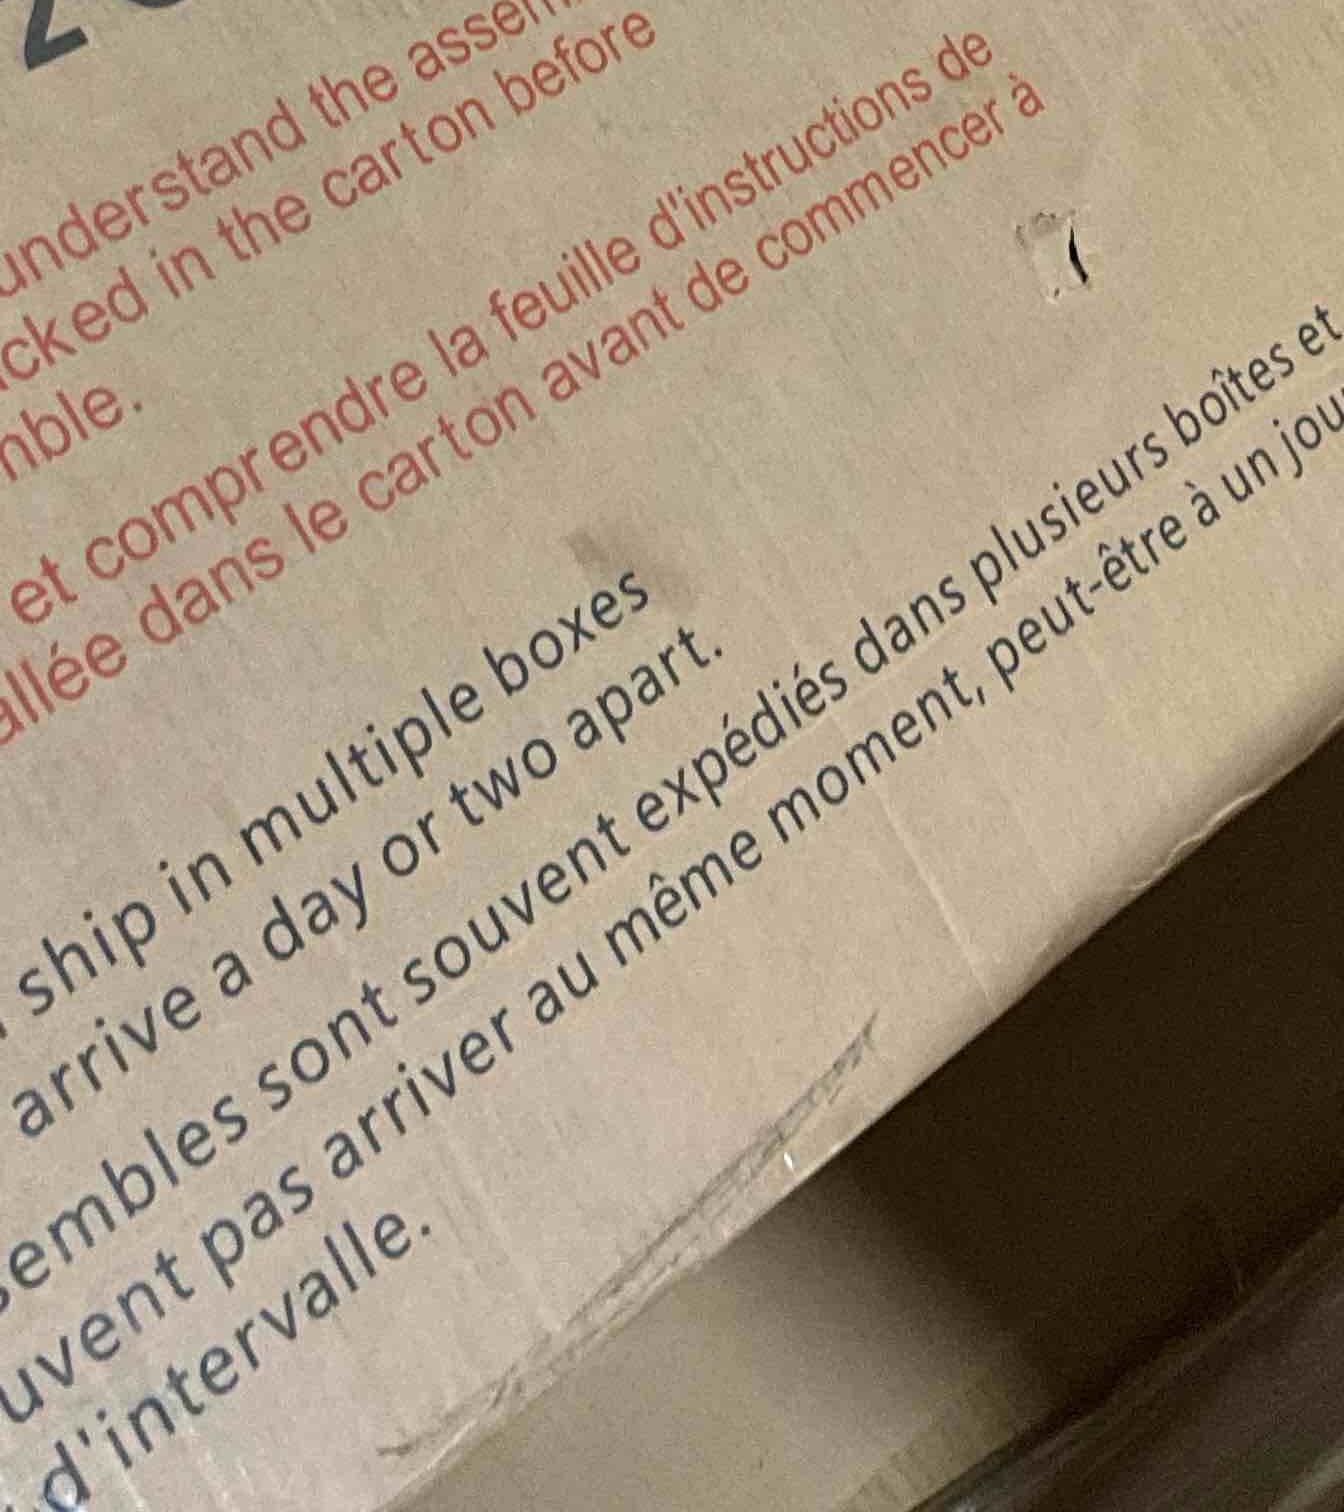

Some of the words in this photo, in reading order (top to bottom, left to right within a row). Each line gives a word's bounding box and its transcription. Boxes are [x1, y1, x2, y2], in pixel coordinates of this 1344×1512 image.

[10, 554, 78, 624] et
[85, 359, 428, 581] comprendre
[429, 327, 487, 377] la
[490, 236, 641, 344] feuille
[648, 60, 933, 252] d'instructions
[937, 27, 993, 83] de
[148, 243, 215, 320] in
[218, 192, 312, 264] the
[323, 97, 495, 208] carton
[494, 11, 657, 117] before
[308, 63, 399, 131] the
[140, 534, 285, 646] dans
[283, 497, 348, 554] le
[358, 385, 536, 513] carton
[541, 288, 685, 403] avant
[686, 255, 750, 316] de
[755, 99, 1008, 271] commencer
[1010, 72, 1045, 118] à
[11, 985, 203, 1139] arrive
[213, 950, 253, 996] a
[262, 864, 369, 962] day
[383, 812, 440, 877] or
[450, 738, 556, 827] two
[565, 625, 724, 751] apart.
[20, 897, 156, 1016] ship
[159, 850, 232, 915] in
[240, 682, 484, 866] multiple
[484, 571, 649, 697] boxes
[201, 1161, 314, 1286] pas
[324, 1007, 513, 1178] arriver
[528, 950, 600, 1025] au
[604, 824, 762, 966] même
[768, 668, 987, 842] moment,
[986, 517, 1187, 692] peut-être
[1194, 480, 1221, 527] à
[1227, 448, 1280, 504] un
[258, 980, 399, 1112] sont
[403, 814, 631, 1005] souvent
[637, 654, 848, 834] expédiés
[855, 575, 966, 675] dans
[971, 429, 1168, 604] plusieurs
[1164, 344, 1295, 446] boîtes
[1297, 303, 1344, 351] et
[42, 1204, 431, 1512] d'intervalle.
